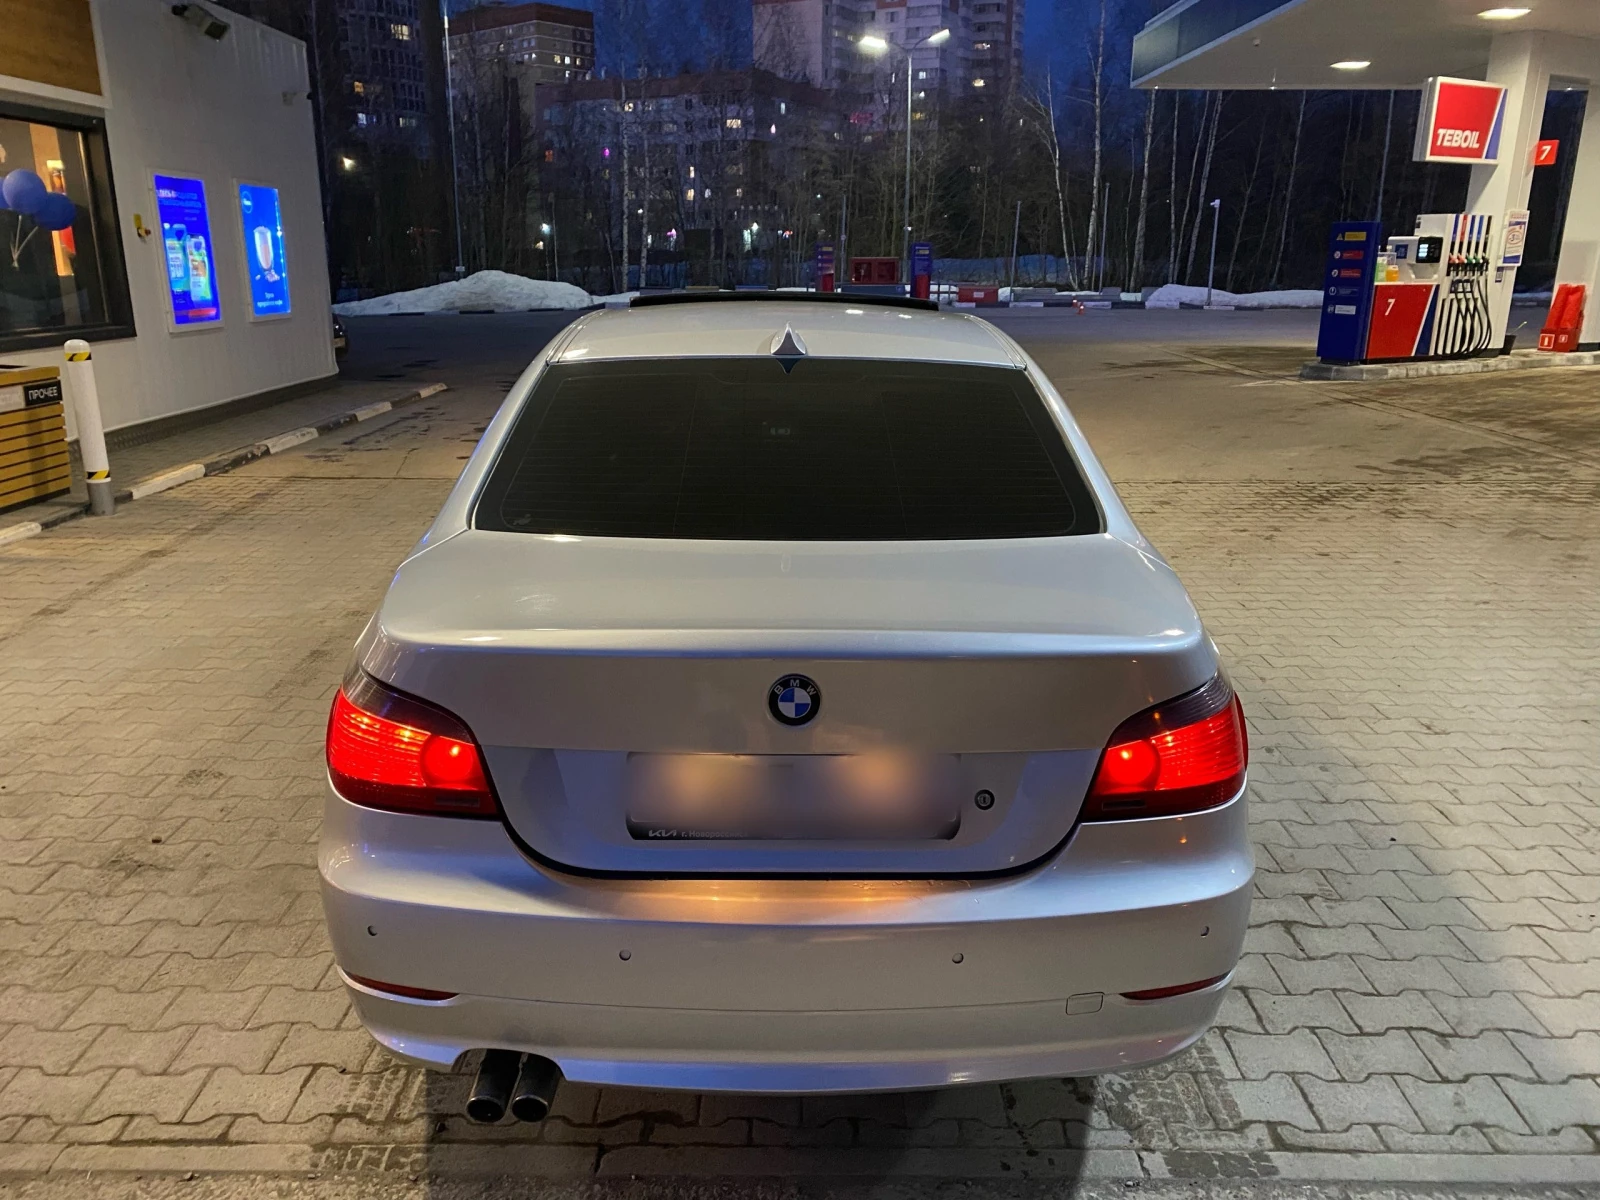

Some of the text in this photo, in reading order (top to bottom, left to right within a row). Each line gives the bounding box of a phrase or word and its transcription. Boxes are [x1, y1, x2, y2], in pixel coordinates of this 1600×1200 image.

[1436, 128, 1480, 149] TEBOIL
[1540, 145, 1552, 161] 7
[1384, 298, 1396, 316] 7
[28, 386, 58, 401] ПРОЧЕЕ
[774, 679, 817, 696] BMW
